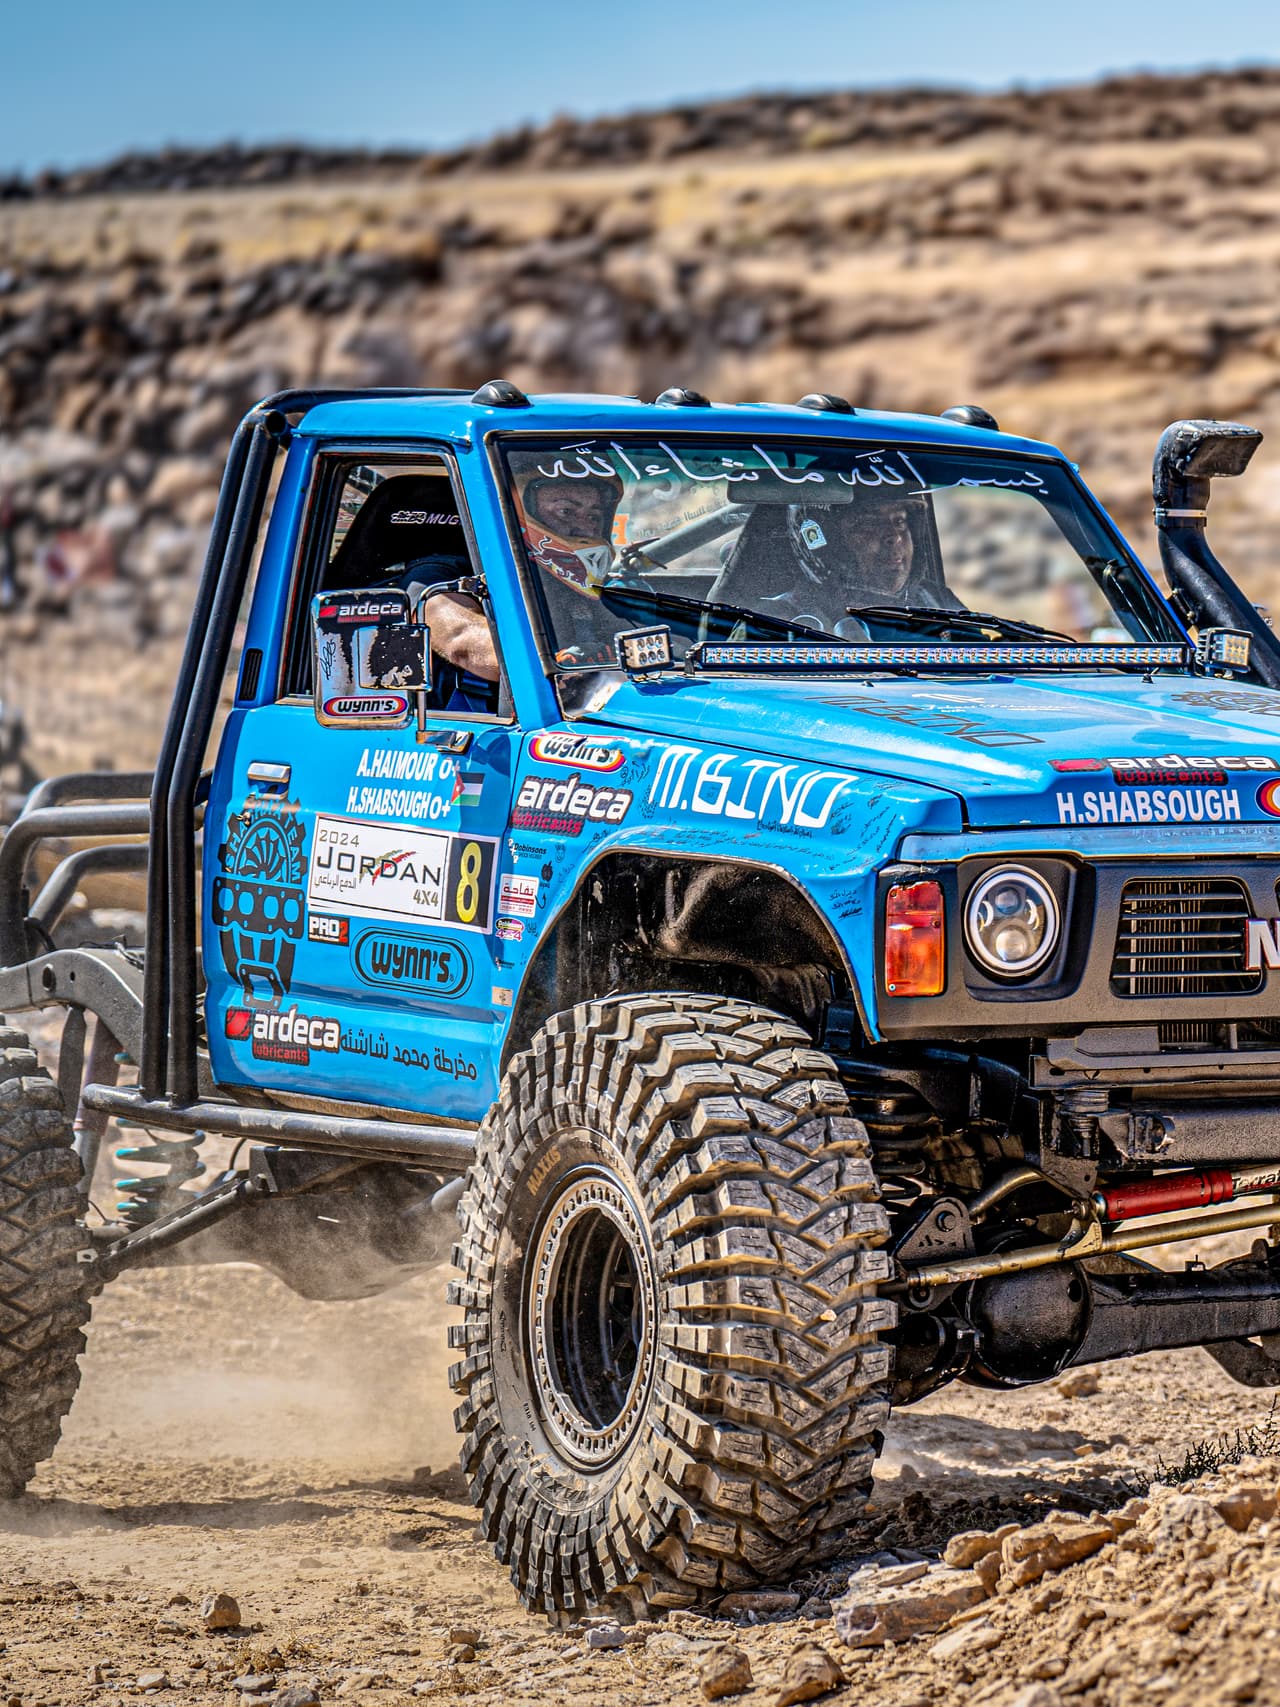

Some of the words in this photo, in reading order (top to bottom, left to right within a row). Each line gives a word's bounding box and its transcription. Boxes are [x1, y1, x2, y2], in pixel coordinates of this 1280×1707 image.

[426, 513, 462, 526] MUG
[339, 601, 402, 617] ardeca
[356, 749, 438, 781] A.HAIMOUR
[1106, 754, 1277, 770] ardeca
[1116, 770, 1225, 782] lubricants
[346, 786, 431, 819] H.SHABSOUGH
[517, 775, 631, 820] ardeca
[1056, 789, 1241, 824] H.SHABSOUGH
[511, 808, 583, 834] lubricants
[319, 829, 360, 848] 2024
[317, 846, 442, 887] JORDAN
[456, 842, 482, 923] 8
[253, 1008, 339, 1049] ardeca
[253, 1043, 308, 1061] lubricants
[393, 1045, 430, 1071] محمد
[433, 1047, 477, 1081] مخرطة
